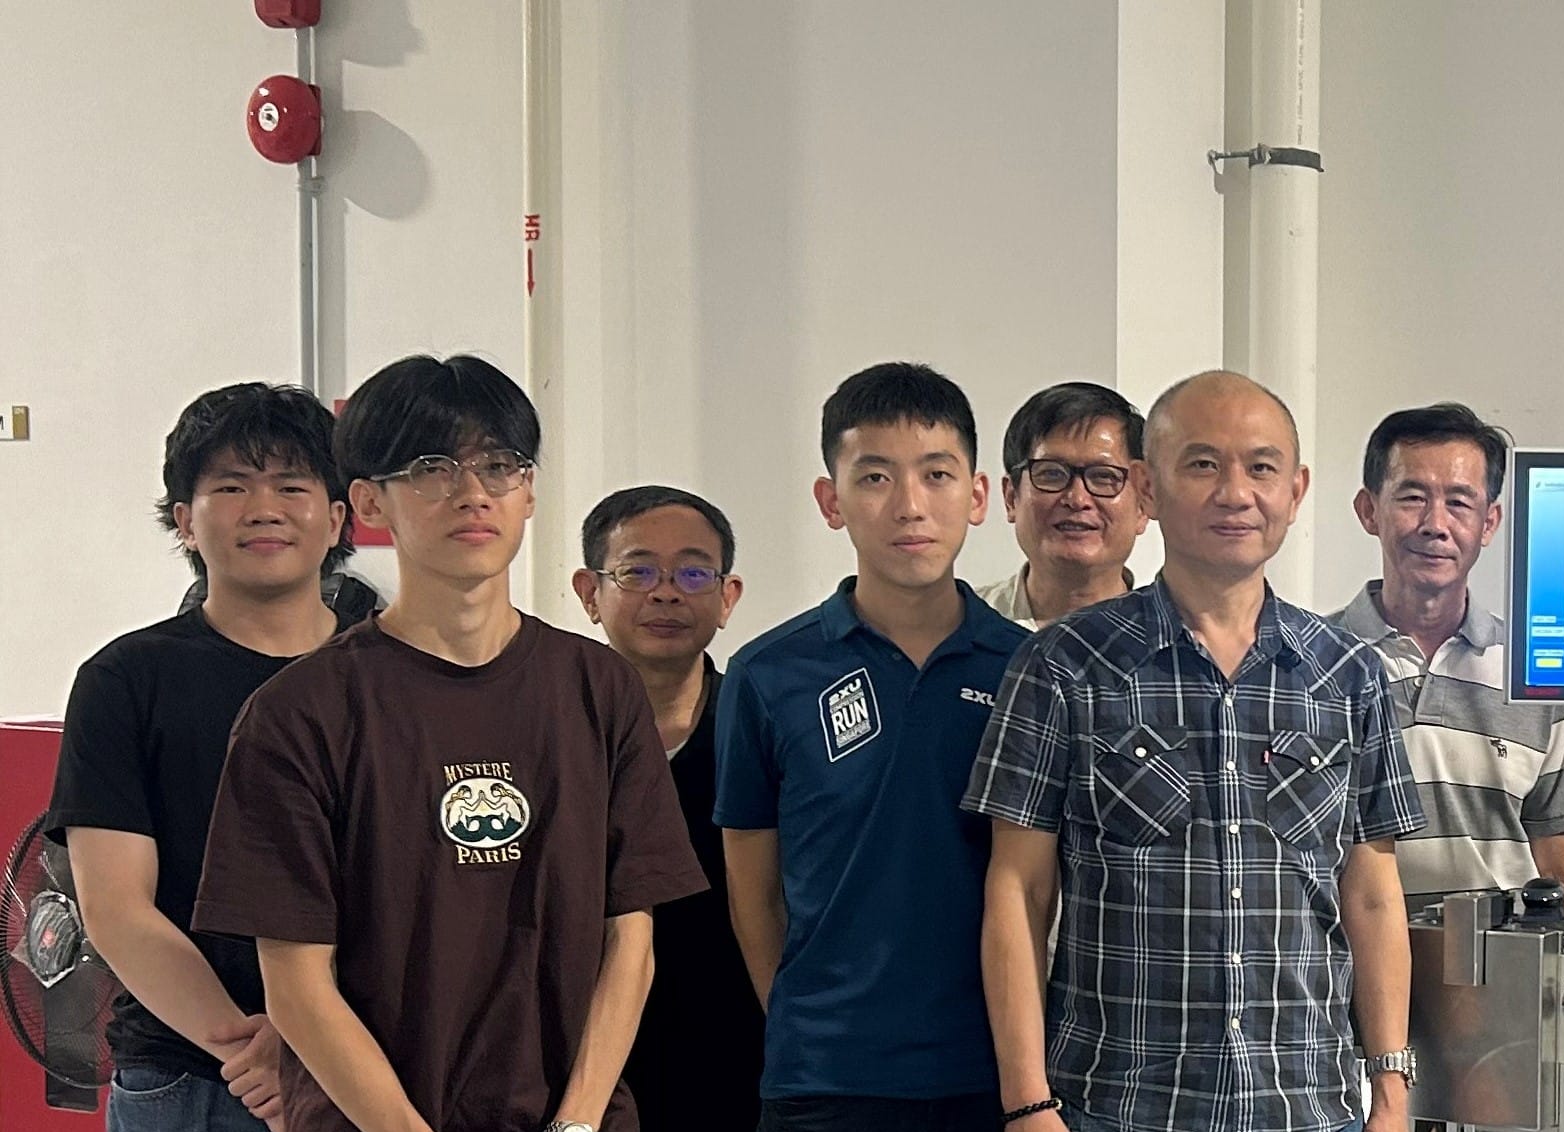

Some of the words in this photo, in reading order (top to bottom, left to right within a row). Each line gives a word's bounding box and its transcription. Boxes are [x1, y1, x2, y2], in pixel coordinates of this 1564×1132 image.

[525, 214, 540, 241] HR
[830, 697, 869, 736] RUN
[456, 842, 522, 865] PARIS
